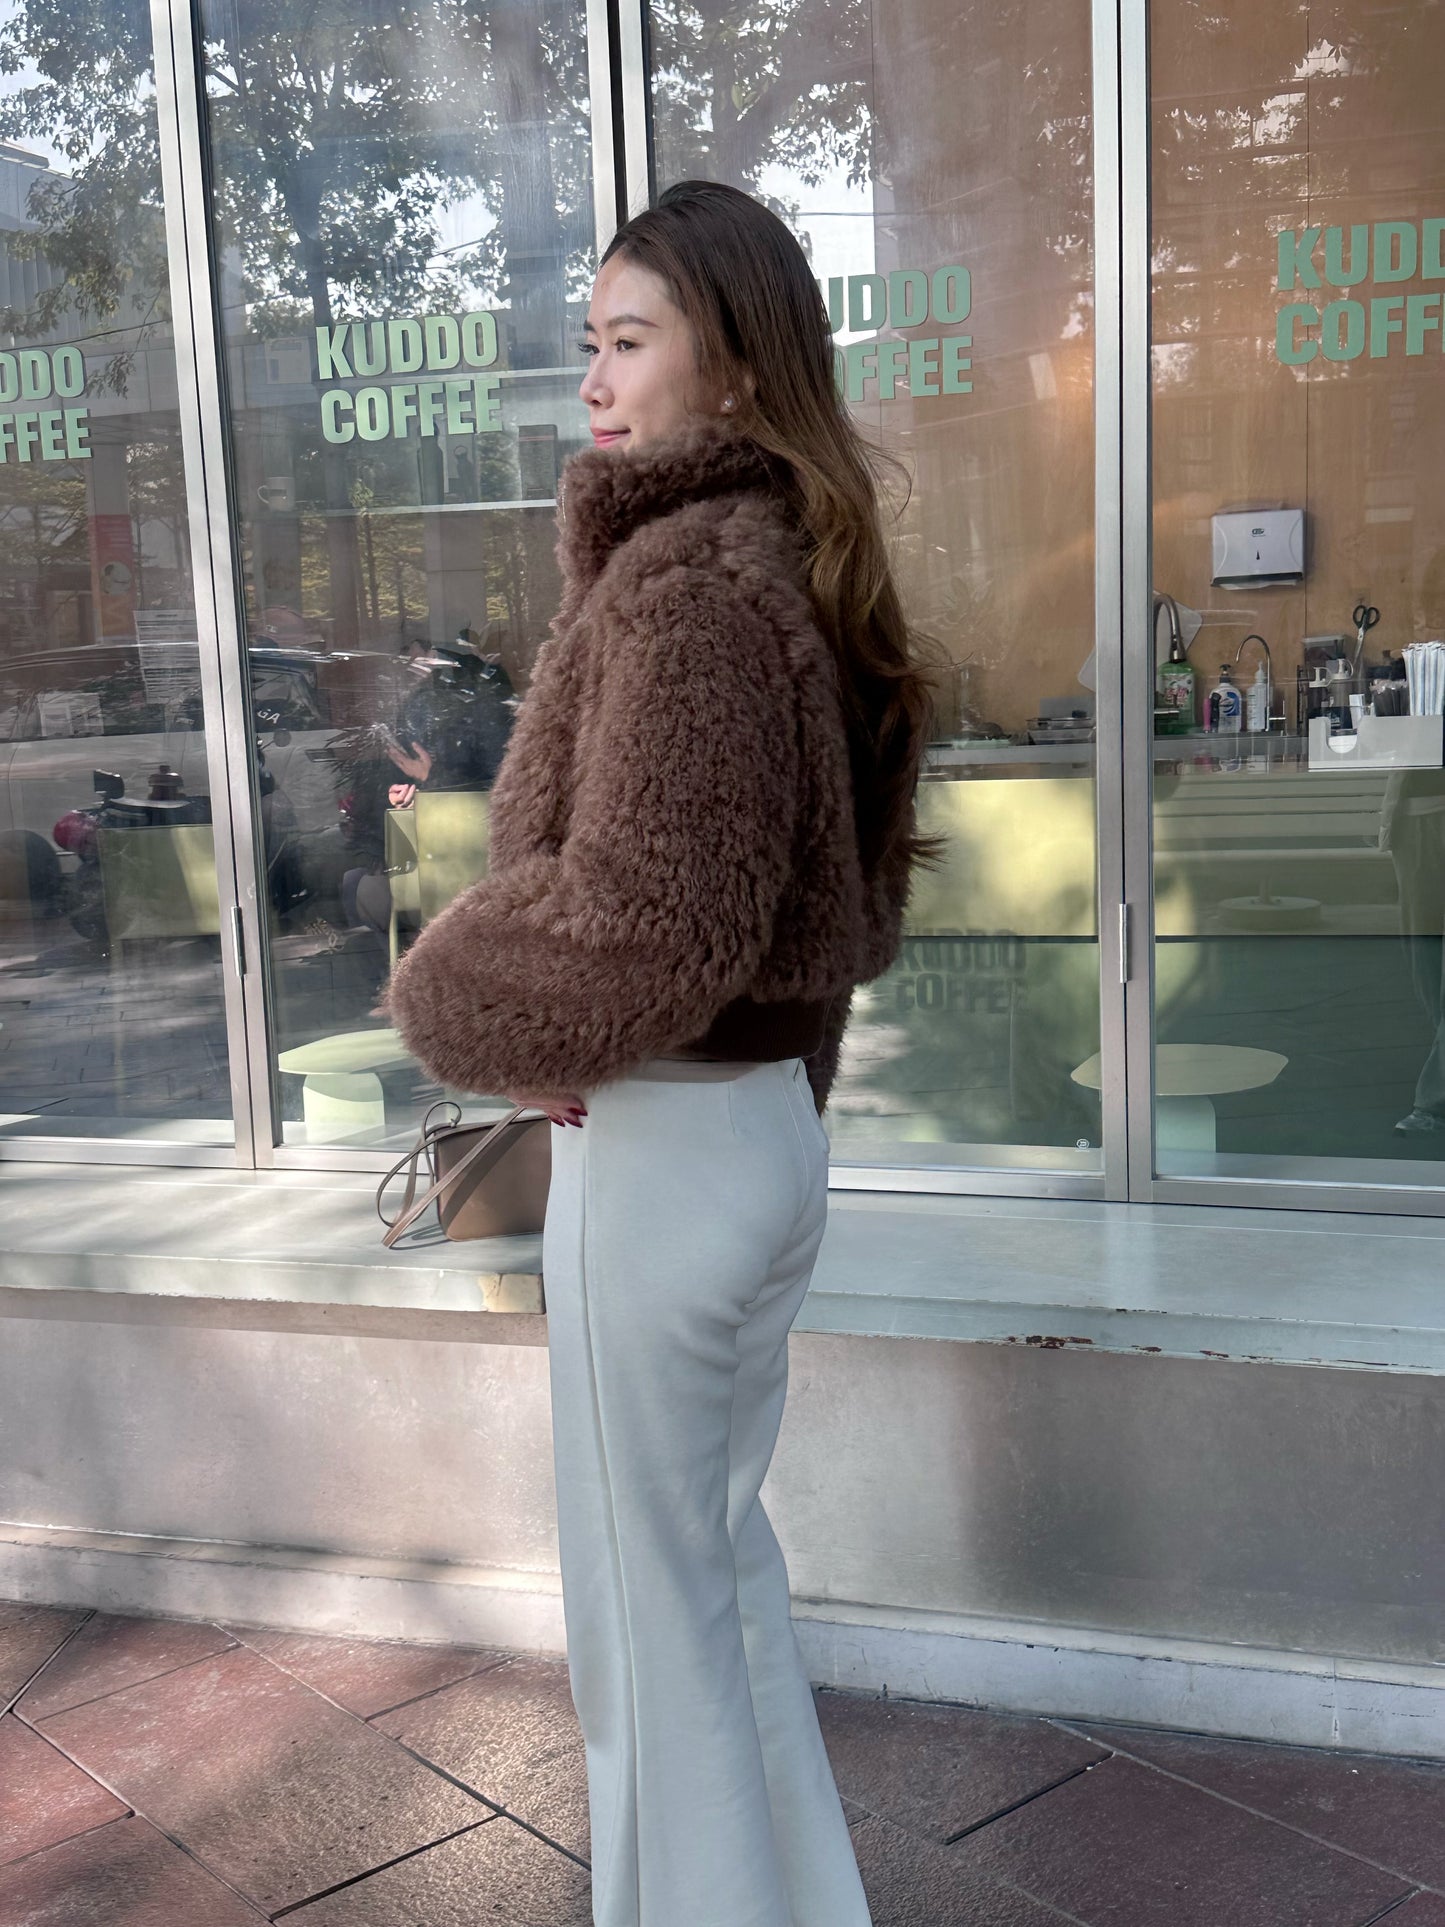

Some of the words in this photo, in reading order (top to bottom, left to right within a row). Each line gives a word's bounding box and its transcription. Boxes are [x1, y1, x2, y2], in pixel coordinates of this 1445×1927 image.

[315, 311, 497, 380] KUDDO
[1275, 293, 1445, 366] COFF
[833, 336, 973, 402] FFEE
[321, 378, 503, 443] COFFEE
